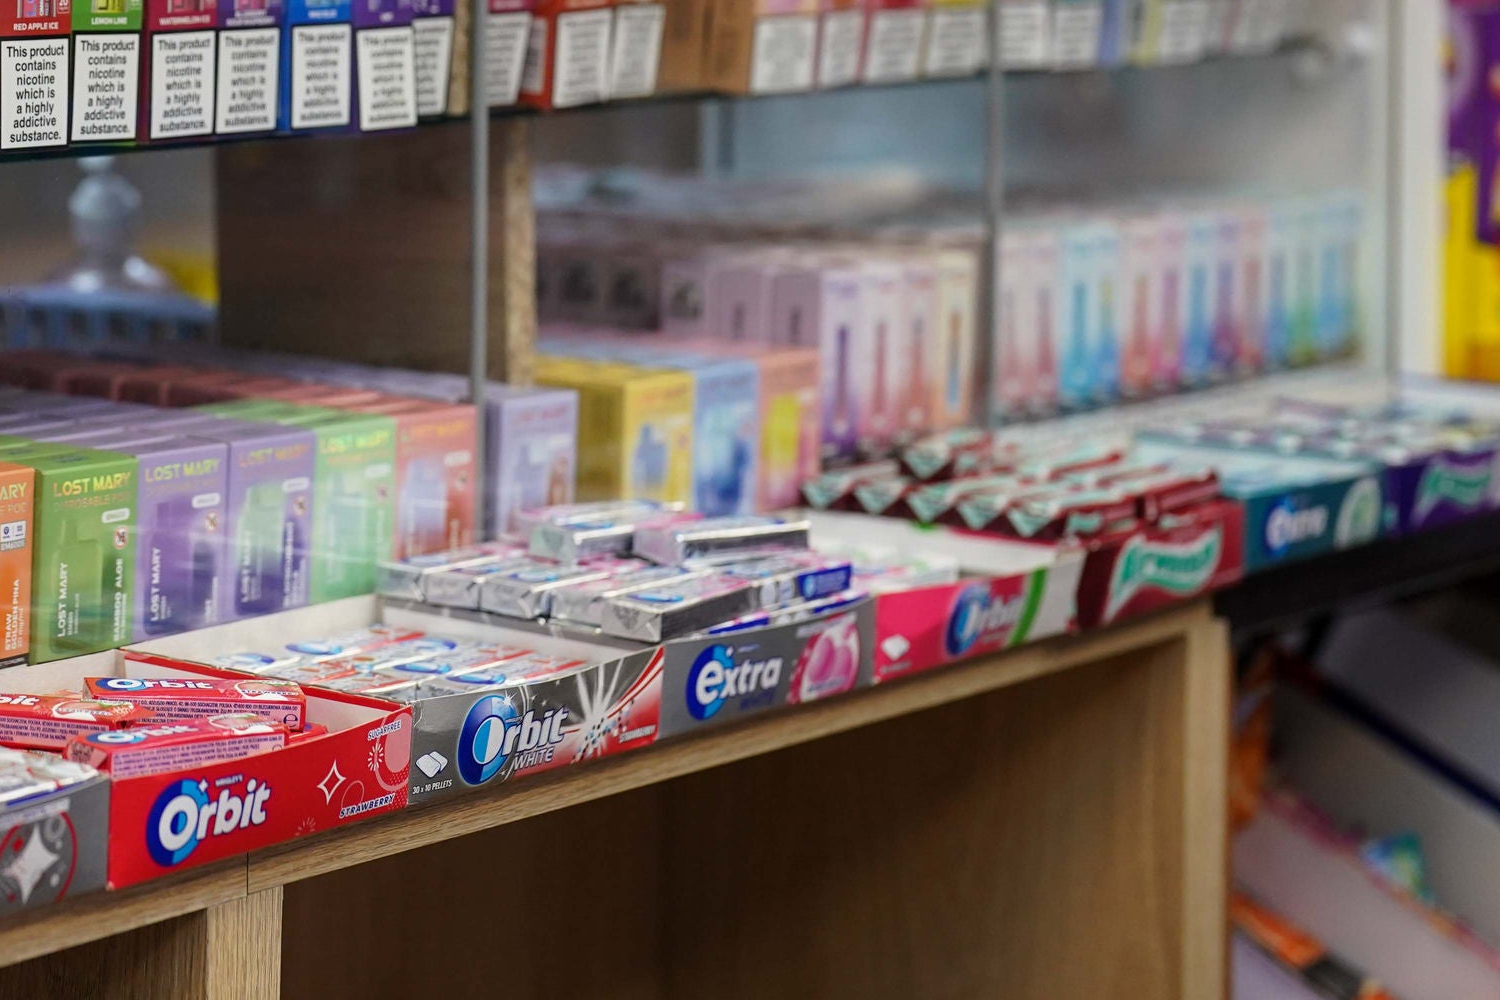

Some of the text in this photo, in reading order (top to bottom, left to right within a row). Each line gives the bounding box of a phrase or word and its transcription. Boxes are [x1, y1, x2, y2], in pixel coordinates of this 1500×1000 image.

[145, 457, 222, 483] LOST MARY
[53, 471, 131, 498] LOST MARY
[11, 579, 20, 650] GOLDEN PINA
[4, 613, 12, 651] STRAW
[105, 677, 215, 690] Orbit
[695, 657, 784, 706] extra
[96, 724, 200, 743] Orbit
[367, 719, 402, 742] SUGARFREE
[511, 745, 555, 772] WHITE
[412, 785, 421, 795] 30
[425, 783, 432, 793] 10
[431, 778, 453, 792] PELLETS
[157, 778, 272, 852] Orbit
[338, 793, 396, 819] STRAWBERRY
